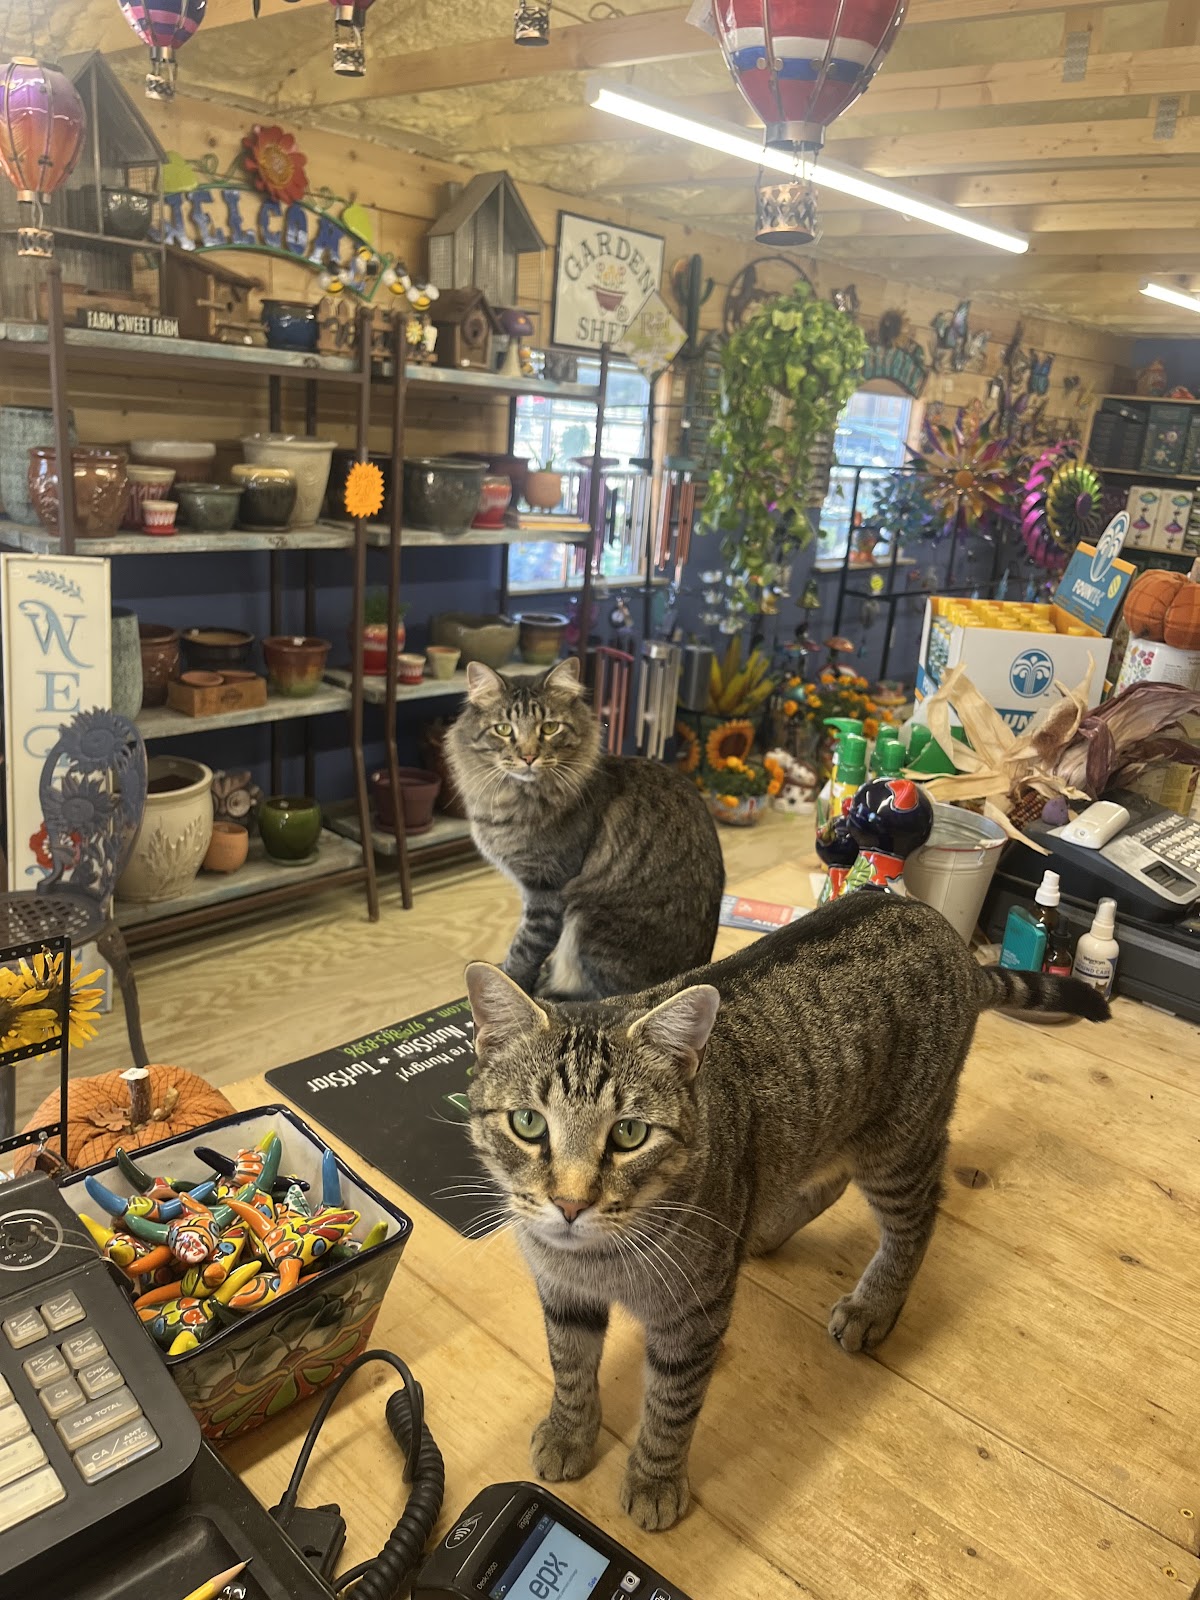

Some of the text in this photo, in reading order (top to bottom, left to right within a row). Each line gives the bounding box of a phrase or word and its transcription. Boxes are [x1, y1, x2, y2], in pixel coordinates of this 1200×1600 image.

[564, 231, 656, 294] GARDEN
[87, 310, 179, 338] FARM SWEET FARM
[306, 1024, 467, 1093] NutriStar TurfStar
[396, 1051, 455, 1082] Hungry!
[31, 1357, 45, 1367] RC
[86, 1366, 105, 1379] CHK
[101, 1371, 115, 1381] NS
[54, 1388, 69, 1399] CH
[72, 1401, 123, 1429] SUB TOTAL
[122, 1427, 143, 1441] AMT
[122, 1431, 149, 1446] TEND
[91, 1448, 110, 1462] CA
[517, 1502, 540, 1530] ingenico
[476, 1561, 499, 1590] Desk/3500
[528, 1551, 569, 1600] epx
[587, 1575, 599, 1589] Sale
